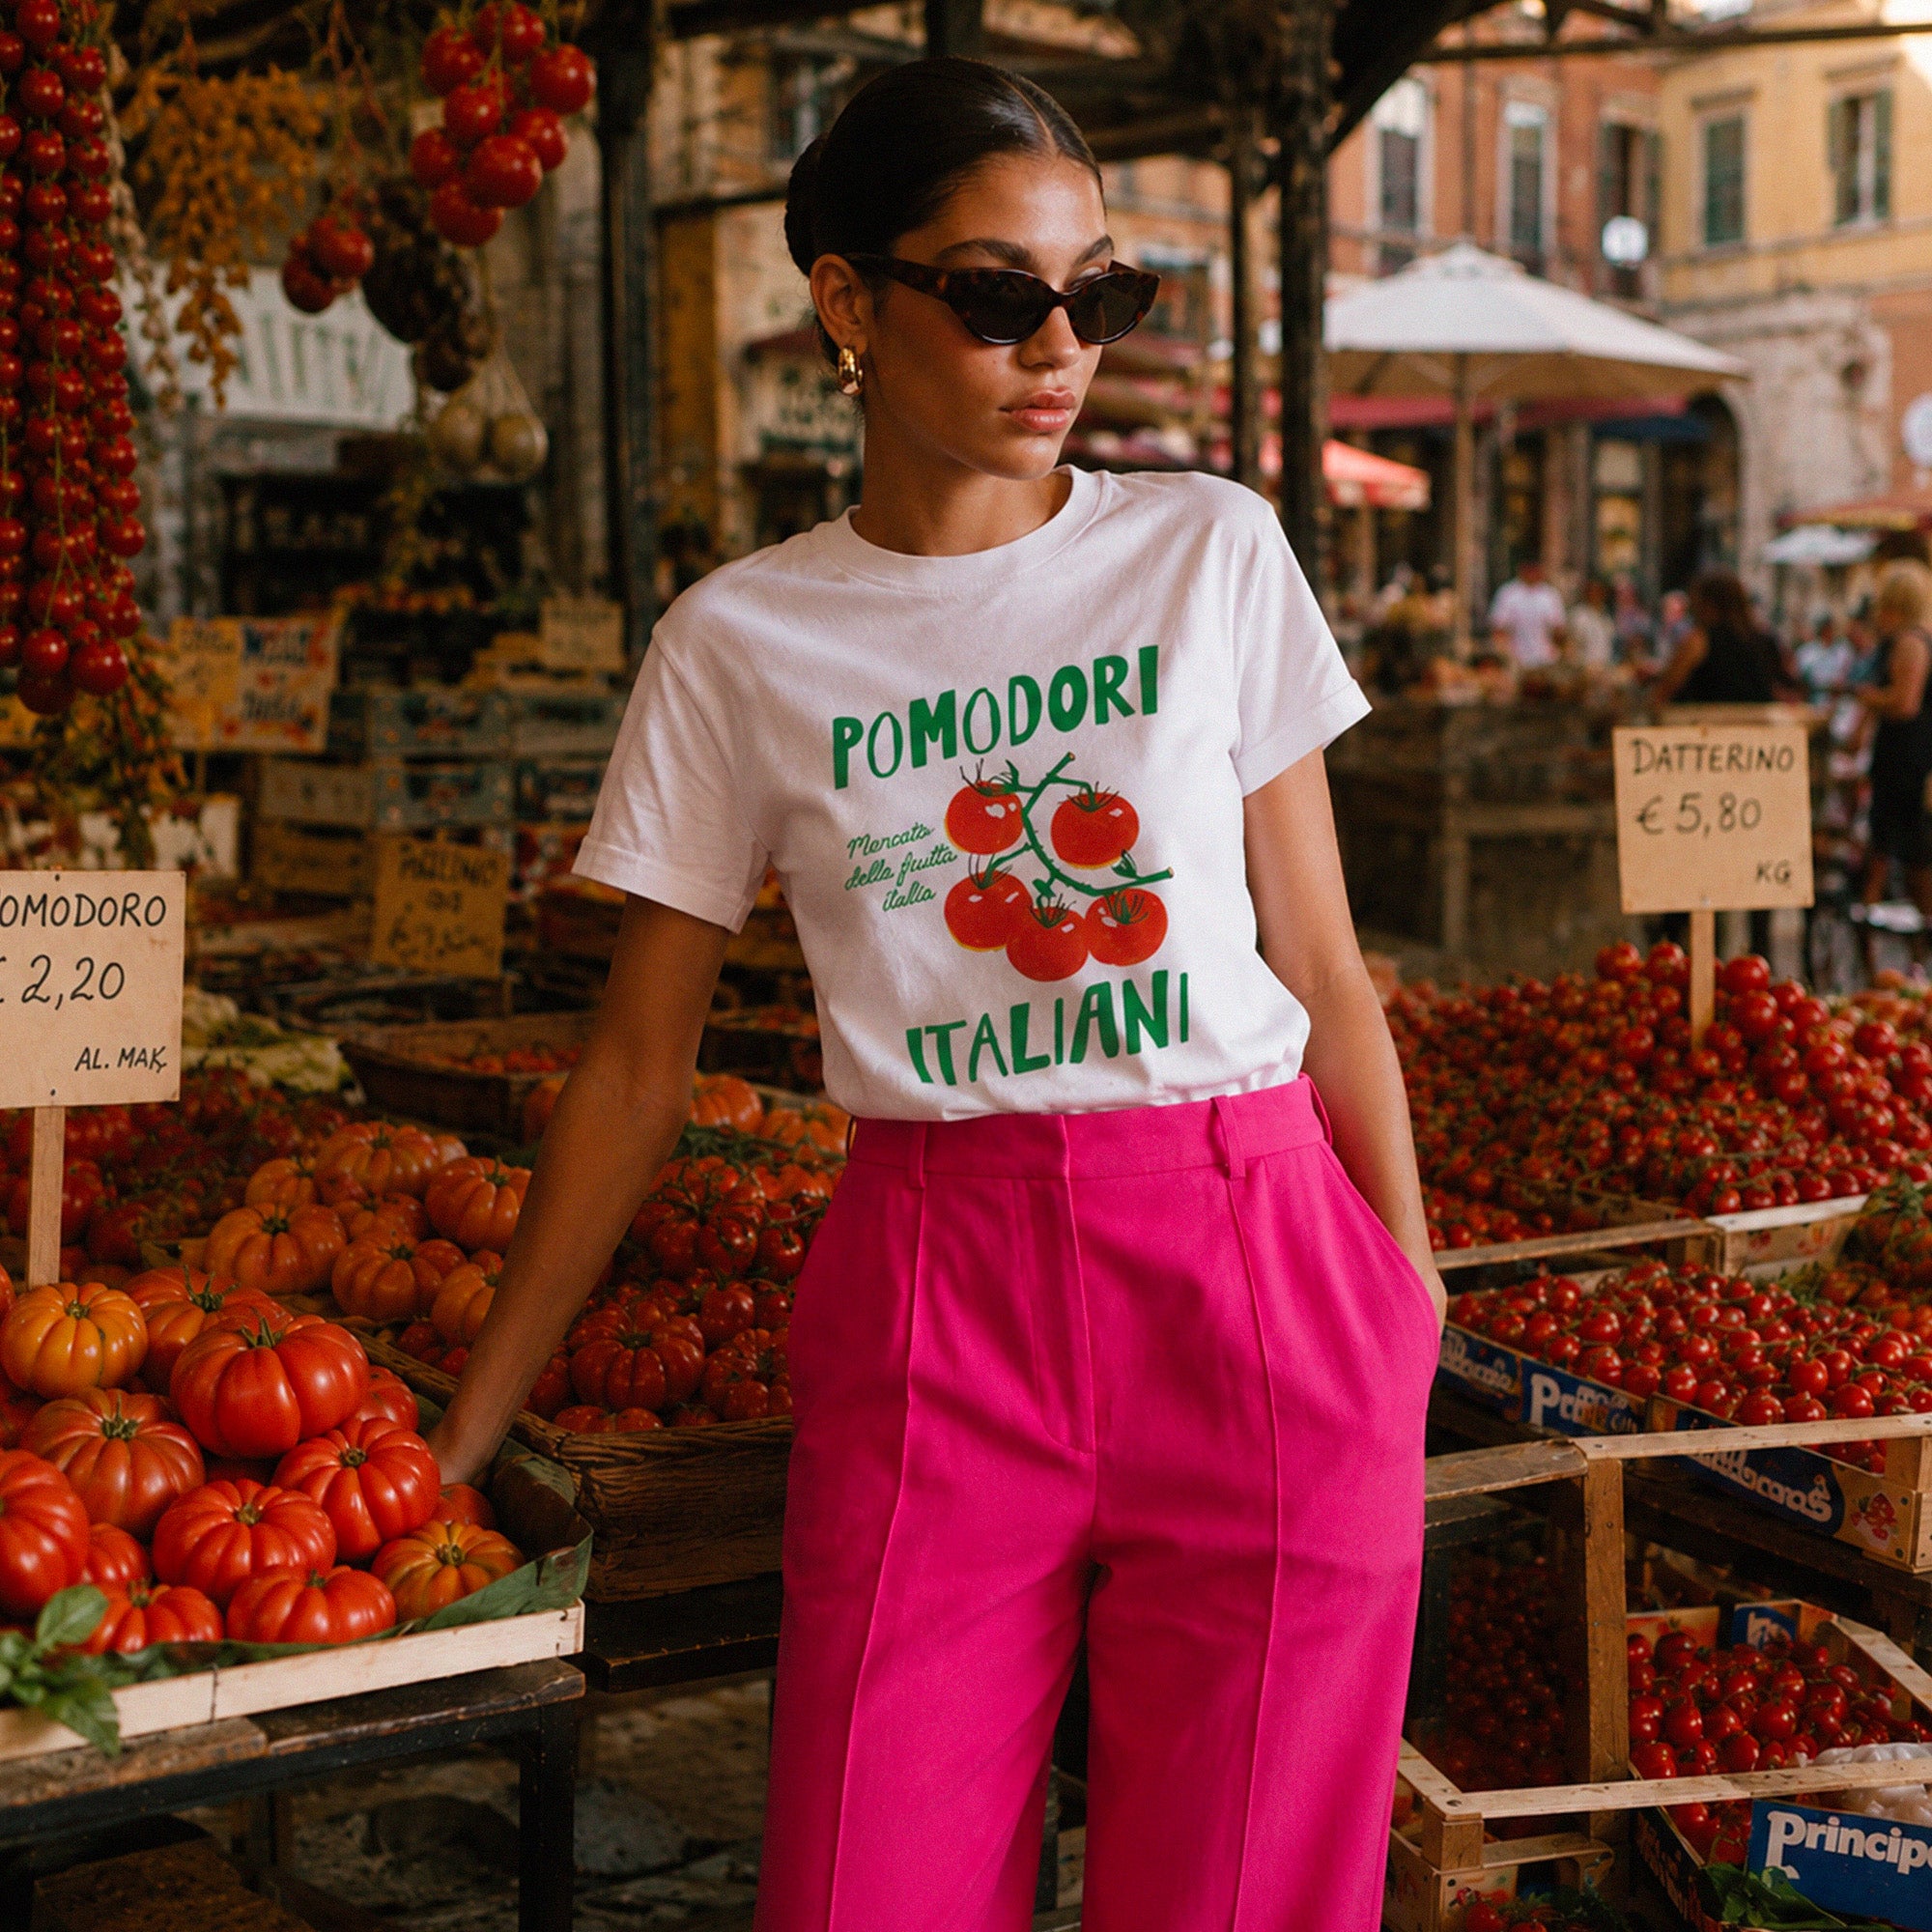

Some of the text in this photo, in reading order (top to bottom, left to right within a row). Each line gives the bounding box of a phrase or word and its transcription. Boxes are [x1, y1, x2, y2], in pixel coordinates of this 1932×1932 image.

[833, 645, 1159, 789] POMODORI
[1632, 737, 1795, 775] DATTERINO
[844, 843, 957, 891] della frutta
[1755, 859, 1793, 885] KG
[0, 892, 167, 927] OMODORO
[882, 881, 936, 912] italia
[21, 954, 126, 1011] 2,20
[905, 970, 1189, 1086] ITALIANI
[74, 1046, 109, 1071] AL.
[1766, 1810, 1932, 1880] Princip
